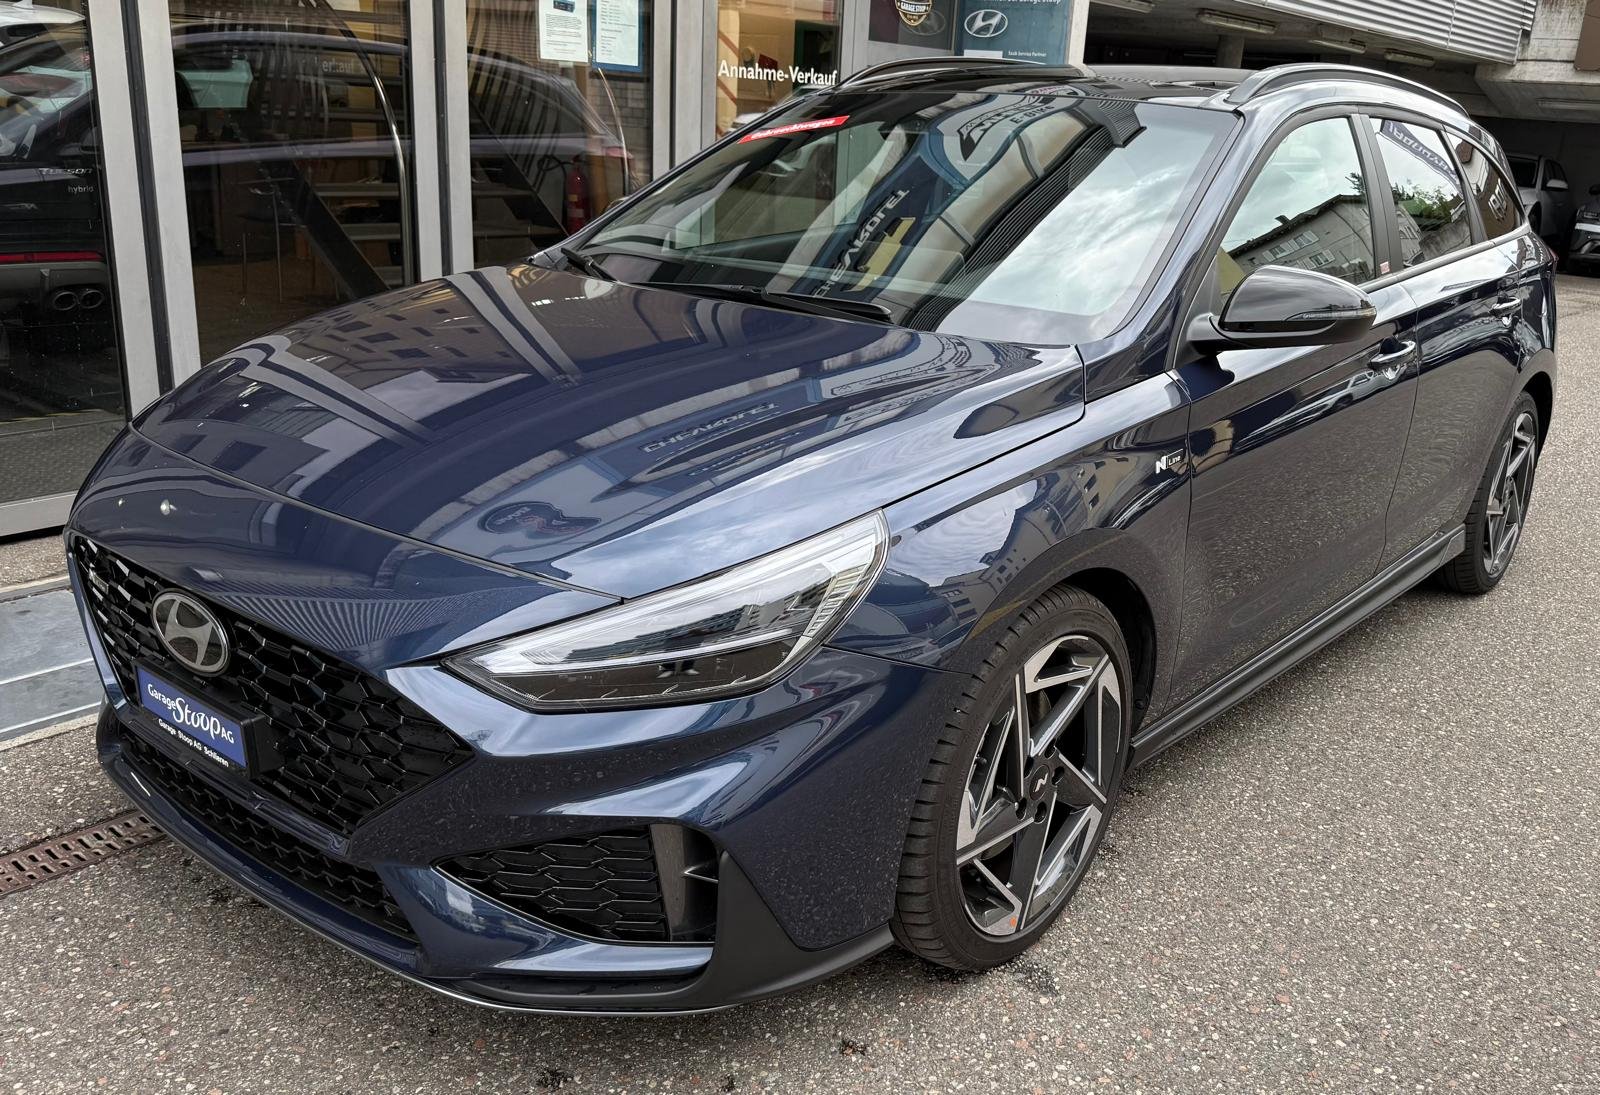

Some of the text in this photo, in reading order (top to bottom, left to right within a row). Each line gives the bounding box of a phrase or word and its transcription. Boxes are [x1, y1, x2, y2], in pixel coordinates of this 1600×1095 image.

[717, 59, 838, 86] Annahme-Verkauf
[67, 185, 94, 195] hybrid
[147, 684, 235, 744] Garage Stoop AG
[158, 718, 177, 735] Garage
